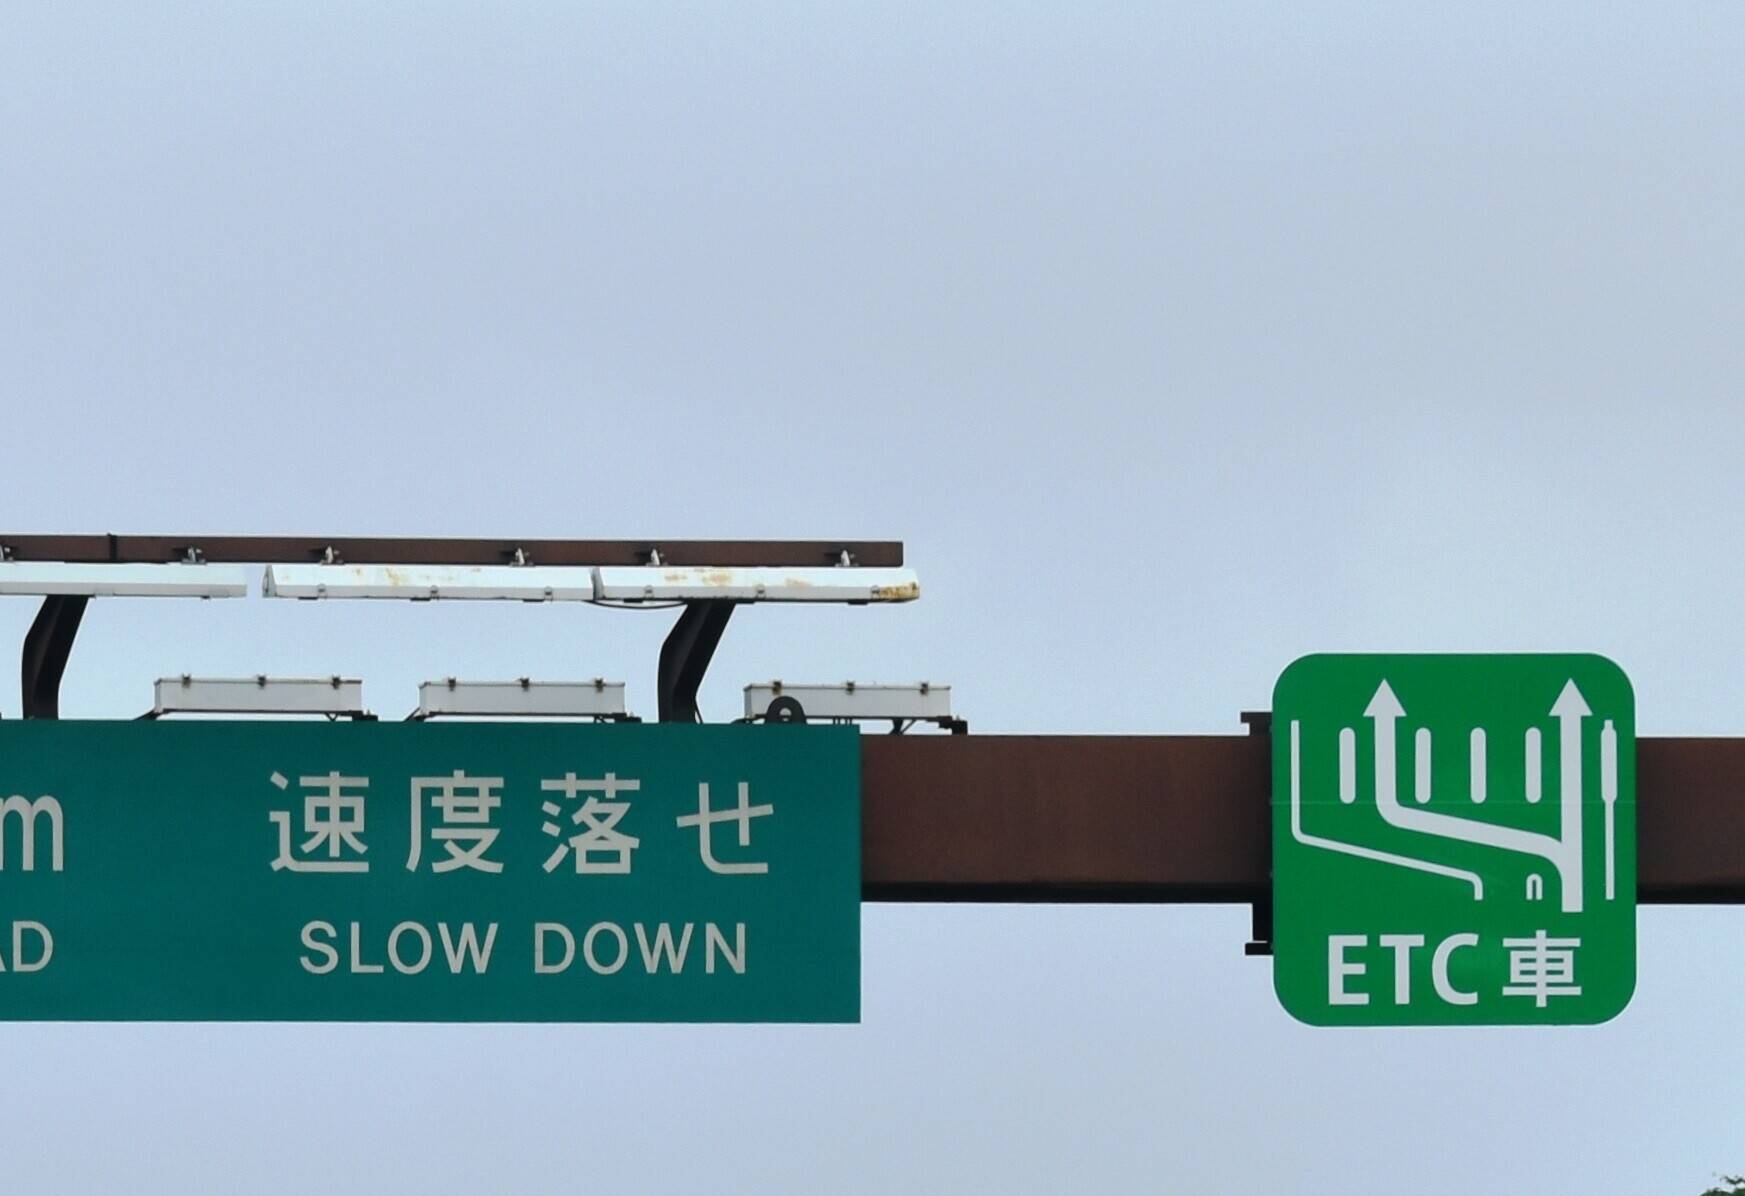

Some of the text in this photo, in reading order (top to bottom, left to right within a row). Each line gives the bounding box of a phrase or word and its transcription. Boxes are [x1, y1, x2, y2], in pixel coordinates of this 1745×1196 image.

[269, 769, 775, 875] 速度落せ
[299, 920, 499, 975] SLOW
[534, 921, 748, 975] DOWN
